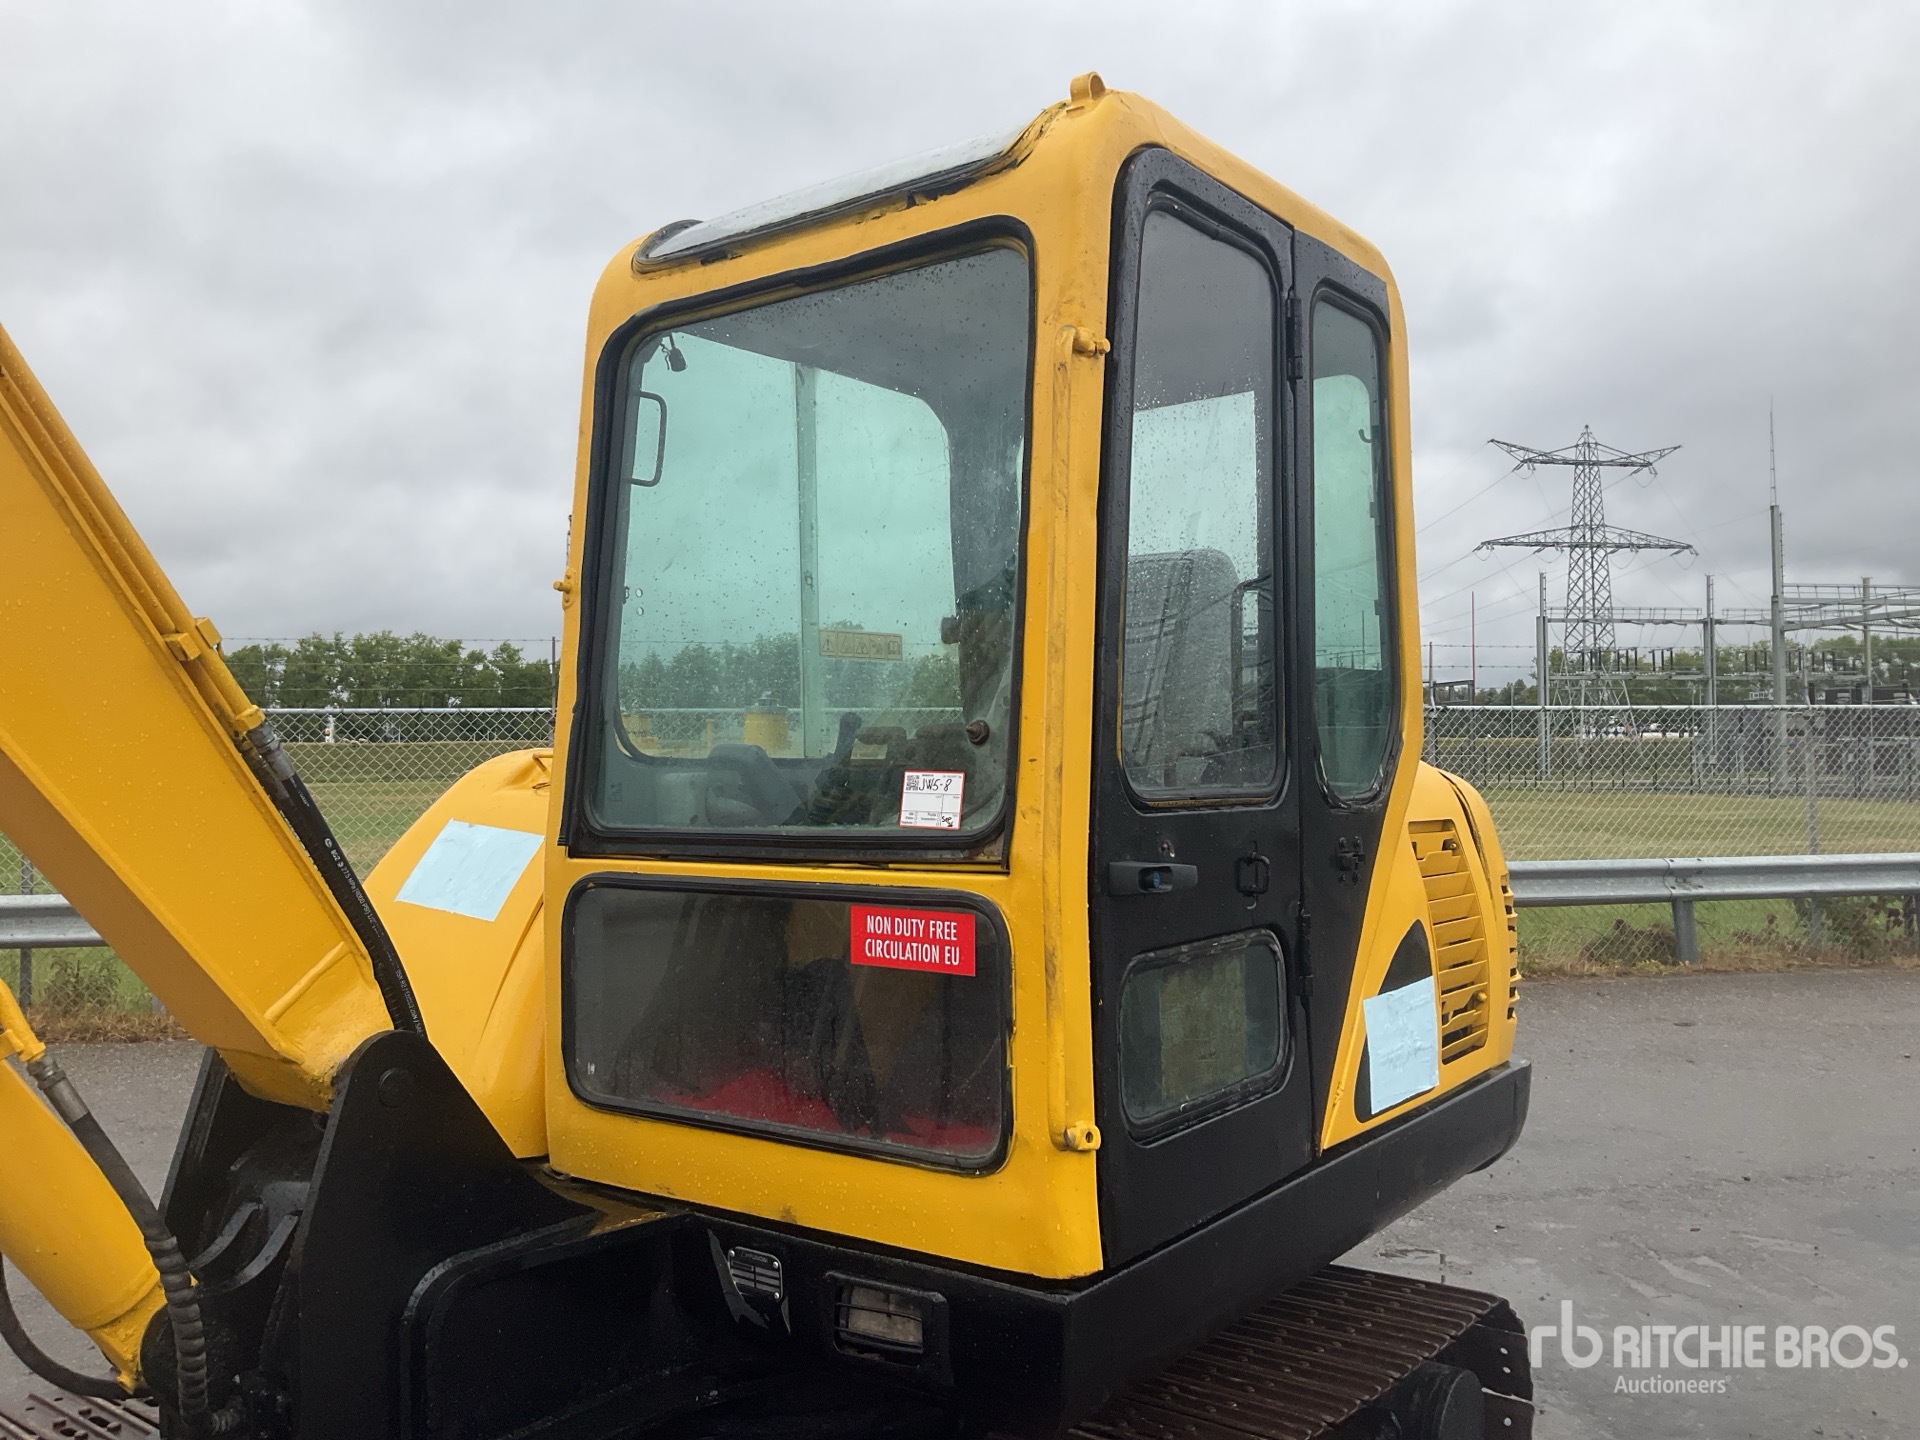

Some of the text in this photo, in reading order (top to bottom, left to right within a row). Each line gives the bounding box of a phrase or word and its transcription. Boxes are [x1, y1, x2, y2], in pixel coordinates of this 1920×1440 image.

[866, 915, 957, 940] NON DUTY FREE
[865, 939, 960, 966] CIRCULATION EU
